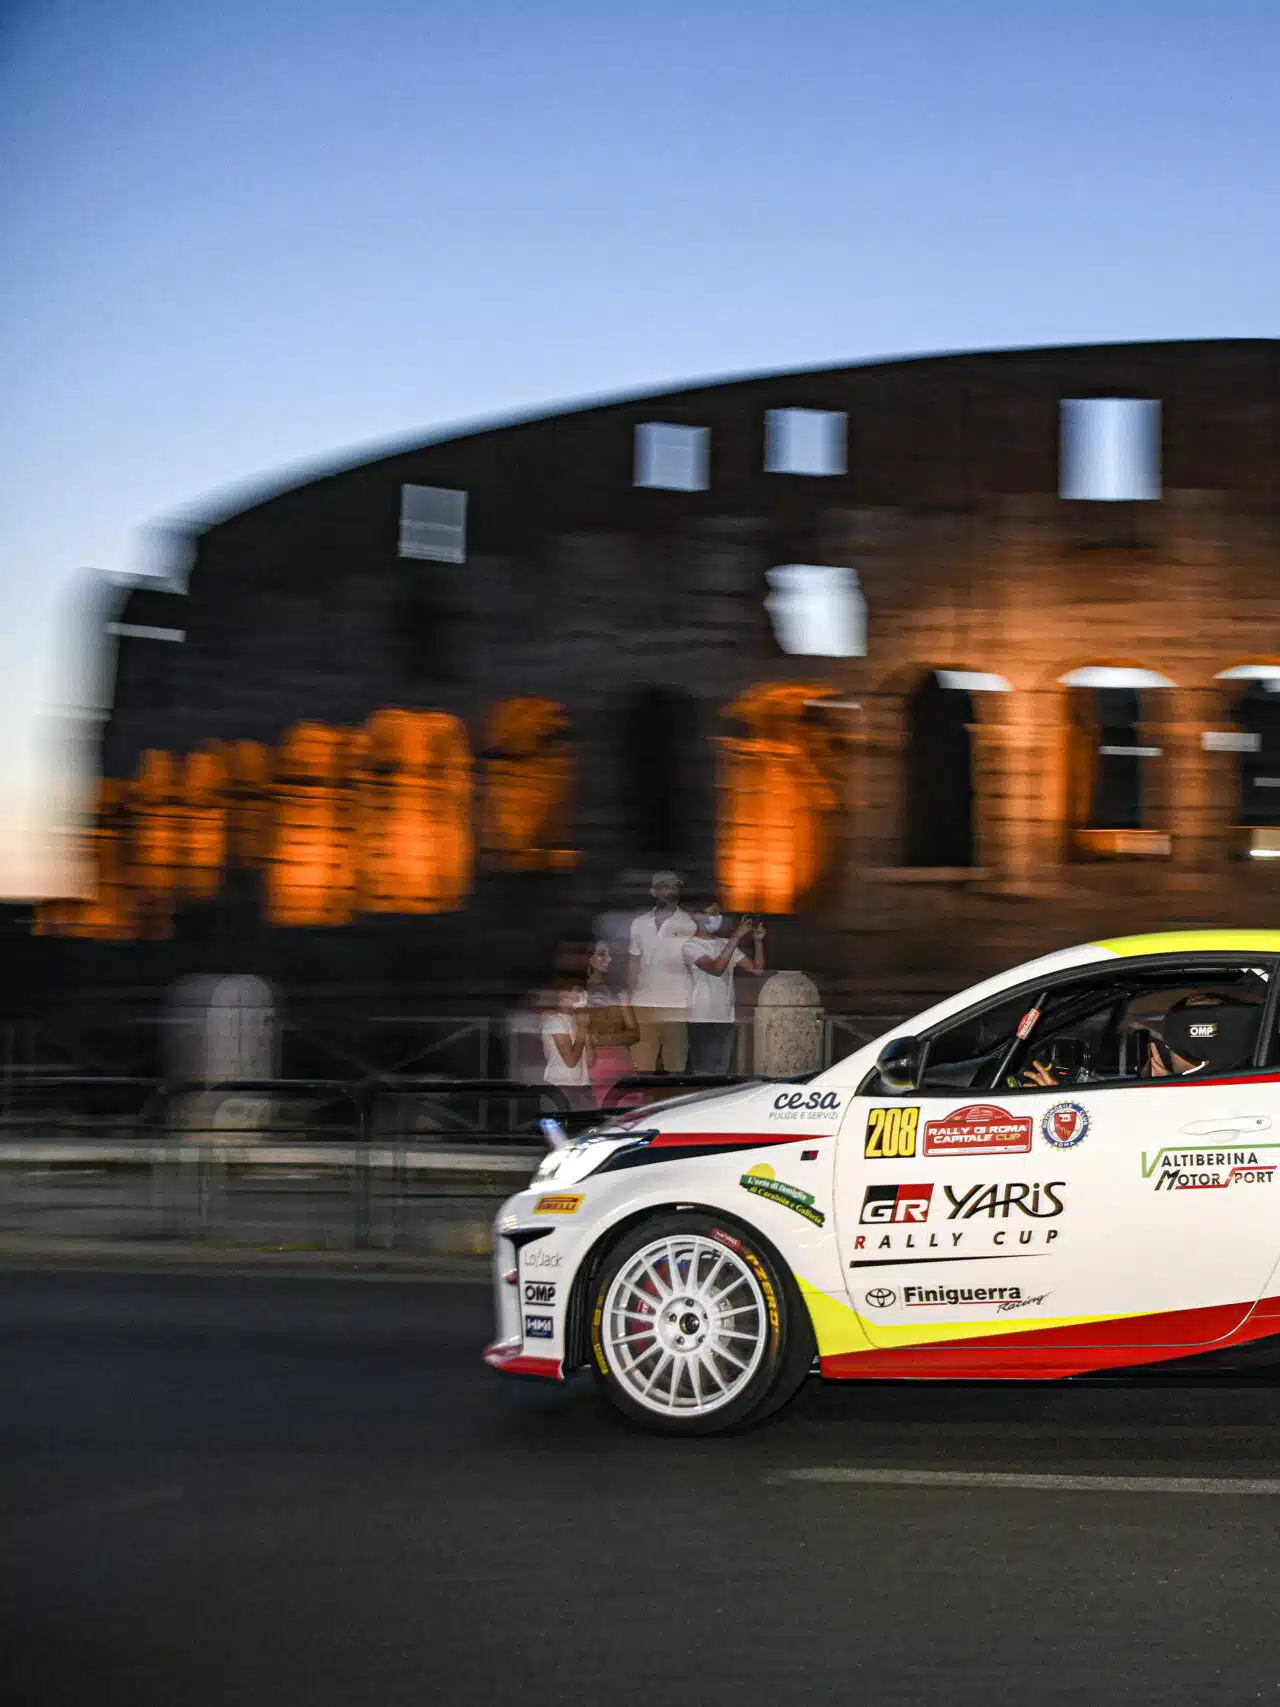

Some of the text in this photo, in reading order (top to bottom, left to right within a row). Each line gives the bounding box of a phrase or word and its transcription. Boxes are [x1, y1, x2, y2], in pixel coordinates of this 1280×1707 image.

[1190, 1026, 1214, 1036] OMP
[774, 1091, 841, 1110] cesa
[866, 1108, 918, 1157] 208
[928, 1127, 970, 1136] RALLY
[989, 1124, 1028, 1133] ROMA
[934, 1133, 1022, 1144] CAPITALE CUP
[1141, 1148, 1260, 1178] VALTIBERINA
[860, 1198, 932, 1224] GR
[854, 1229, 1058, 1250] RALLY CUP
[525, 1284, 556, 1302] OMP
[903, 1285, 1021, 1304] Finiguerra
[997, 1291, 1053, 1313] Racing
